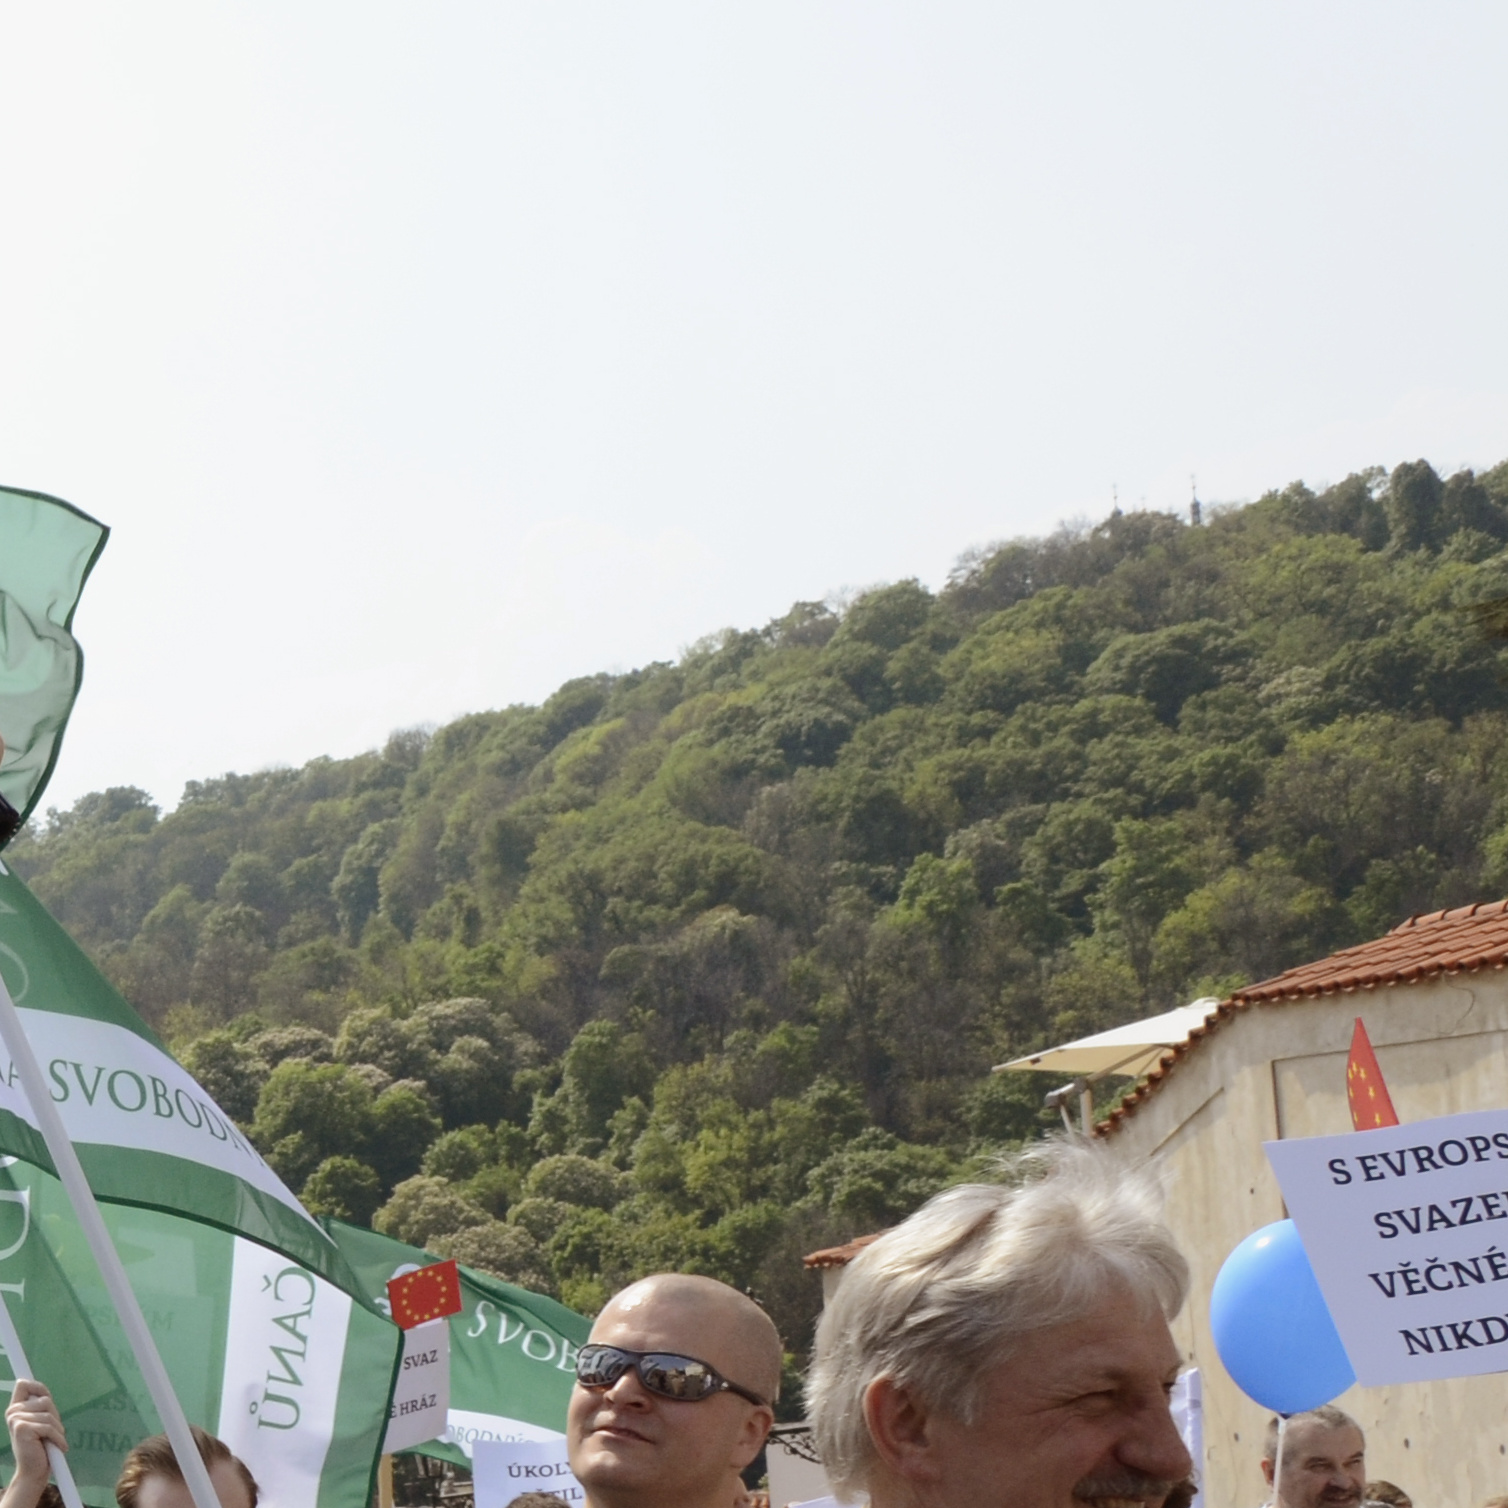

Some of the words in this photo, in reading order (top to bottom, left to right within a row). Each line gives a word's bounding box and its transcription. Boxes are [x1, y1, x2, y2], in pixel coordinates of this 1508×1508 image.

[48, 1058, 266, 1166] SVOBODN
[1327, 1157, 1353, 1186] S
[1373, 1190, 1508, 1239] SVAZE
[1398, 1313, 1508, 1357] NIKD
[402, 1349, 439, 1371] SVAZ
[399, 1392, 438, 1418] HRÁZ
